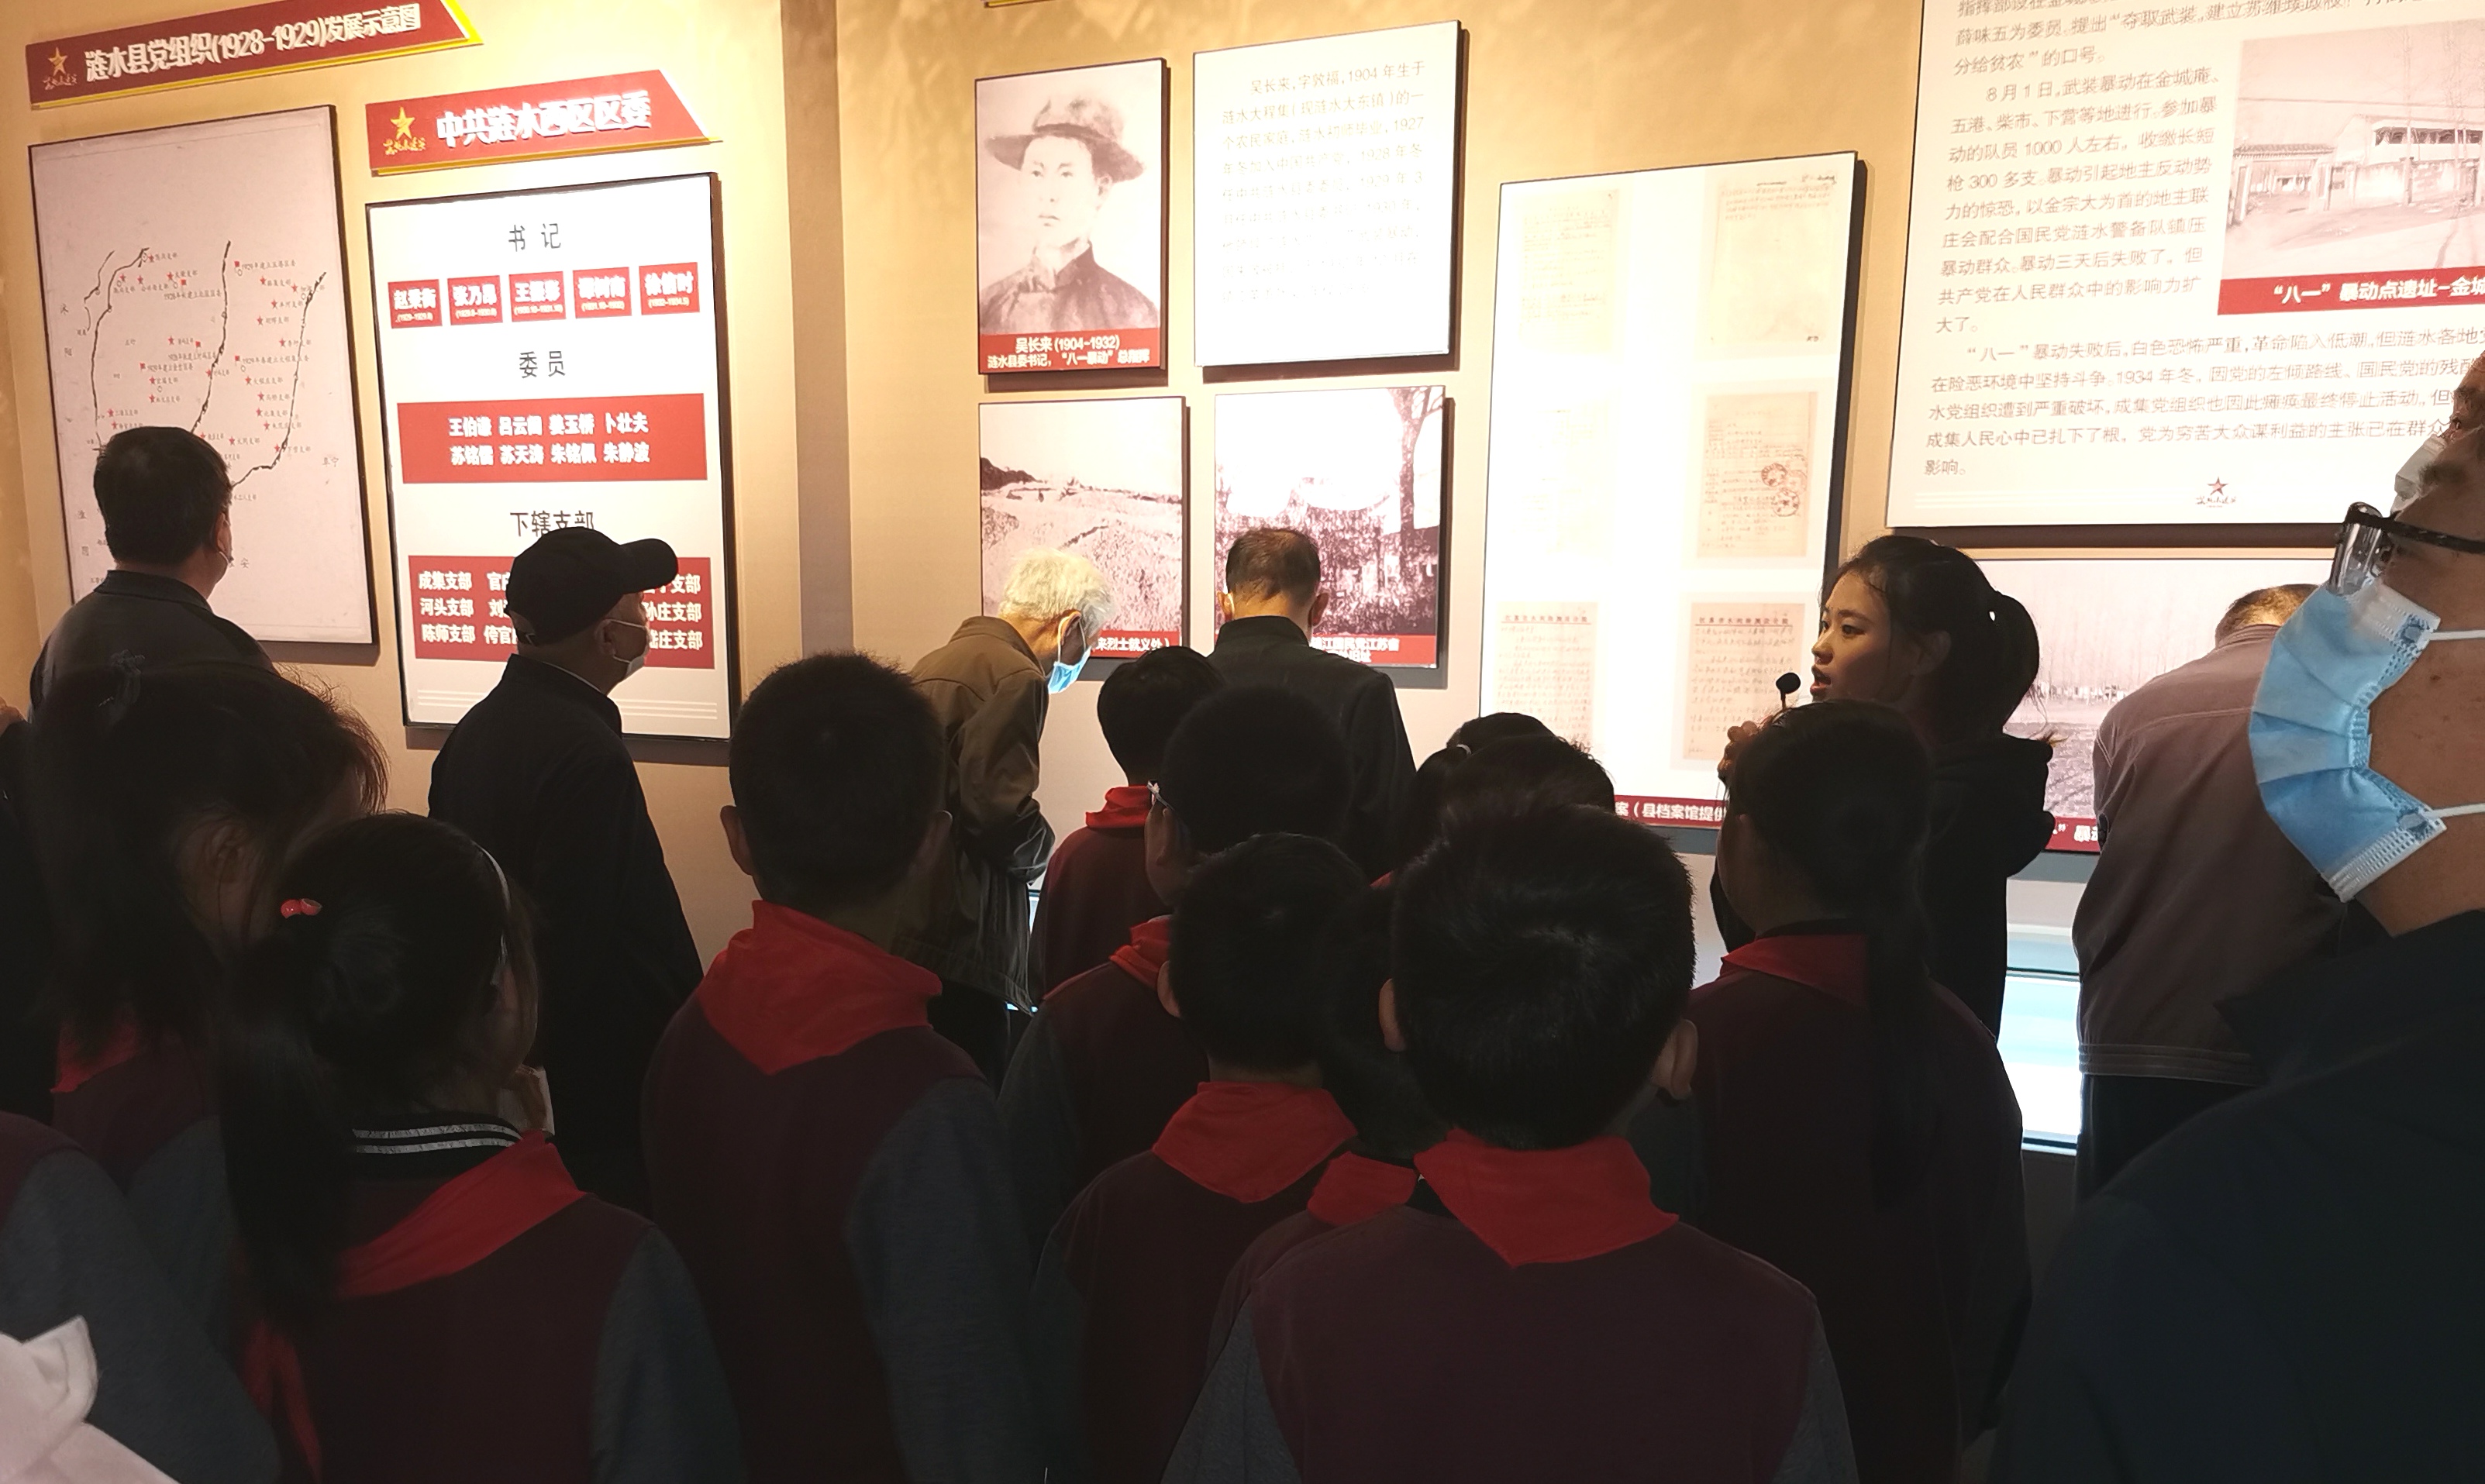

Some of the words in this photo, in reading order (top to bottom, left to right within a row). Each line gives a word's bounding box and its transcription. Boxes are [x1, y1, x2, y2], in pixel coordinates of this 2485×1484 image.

[84, 2, 422, 82] 涟水县党组织(1928-1929)发展示意图
[436, 89, 652, 148] 中共涟水西区区委
[508, 222, 561, 253] 书记
[1938, 276, 2201, 305] 共产党在人民群众中的影响力扩
[1015, 334, 1120, 353] 吴长来(1904-1932)
[1966, 326, 2485, 362] “八一”暴动失败后，白色恐怖严重，革命陷入低潮，但涟水各地
[519, 350, 566, 379] 委员
[1928, 388, 2454, 421] 水党组织遭到严重破坏，成集党组织也因此瘫痪最终停止活动，但
[419, 570, 472, 591] 成集支部
[420, 597, 474, 618] 河头支部
